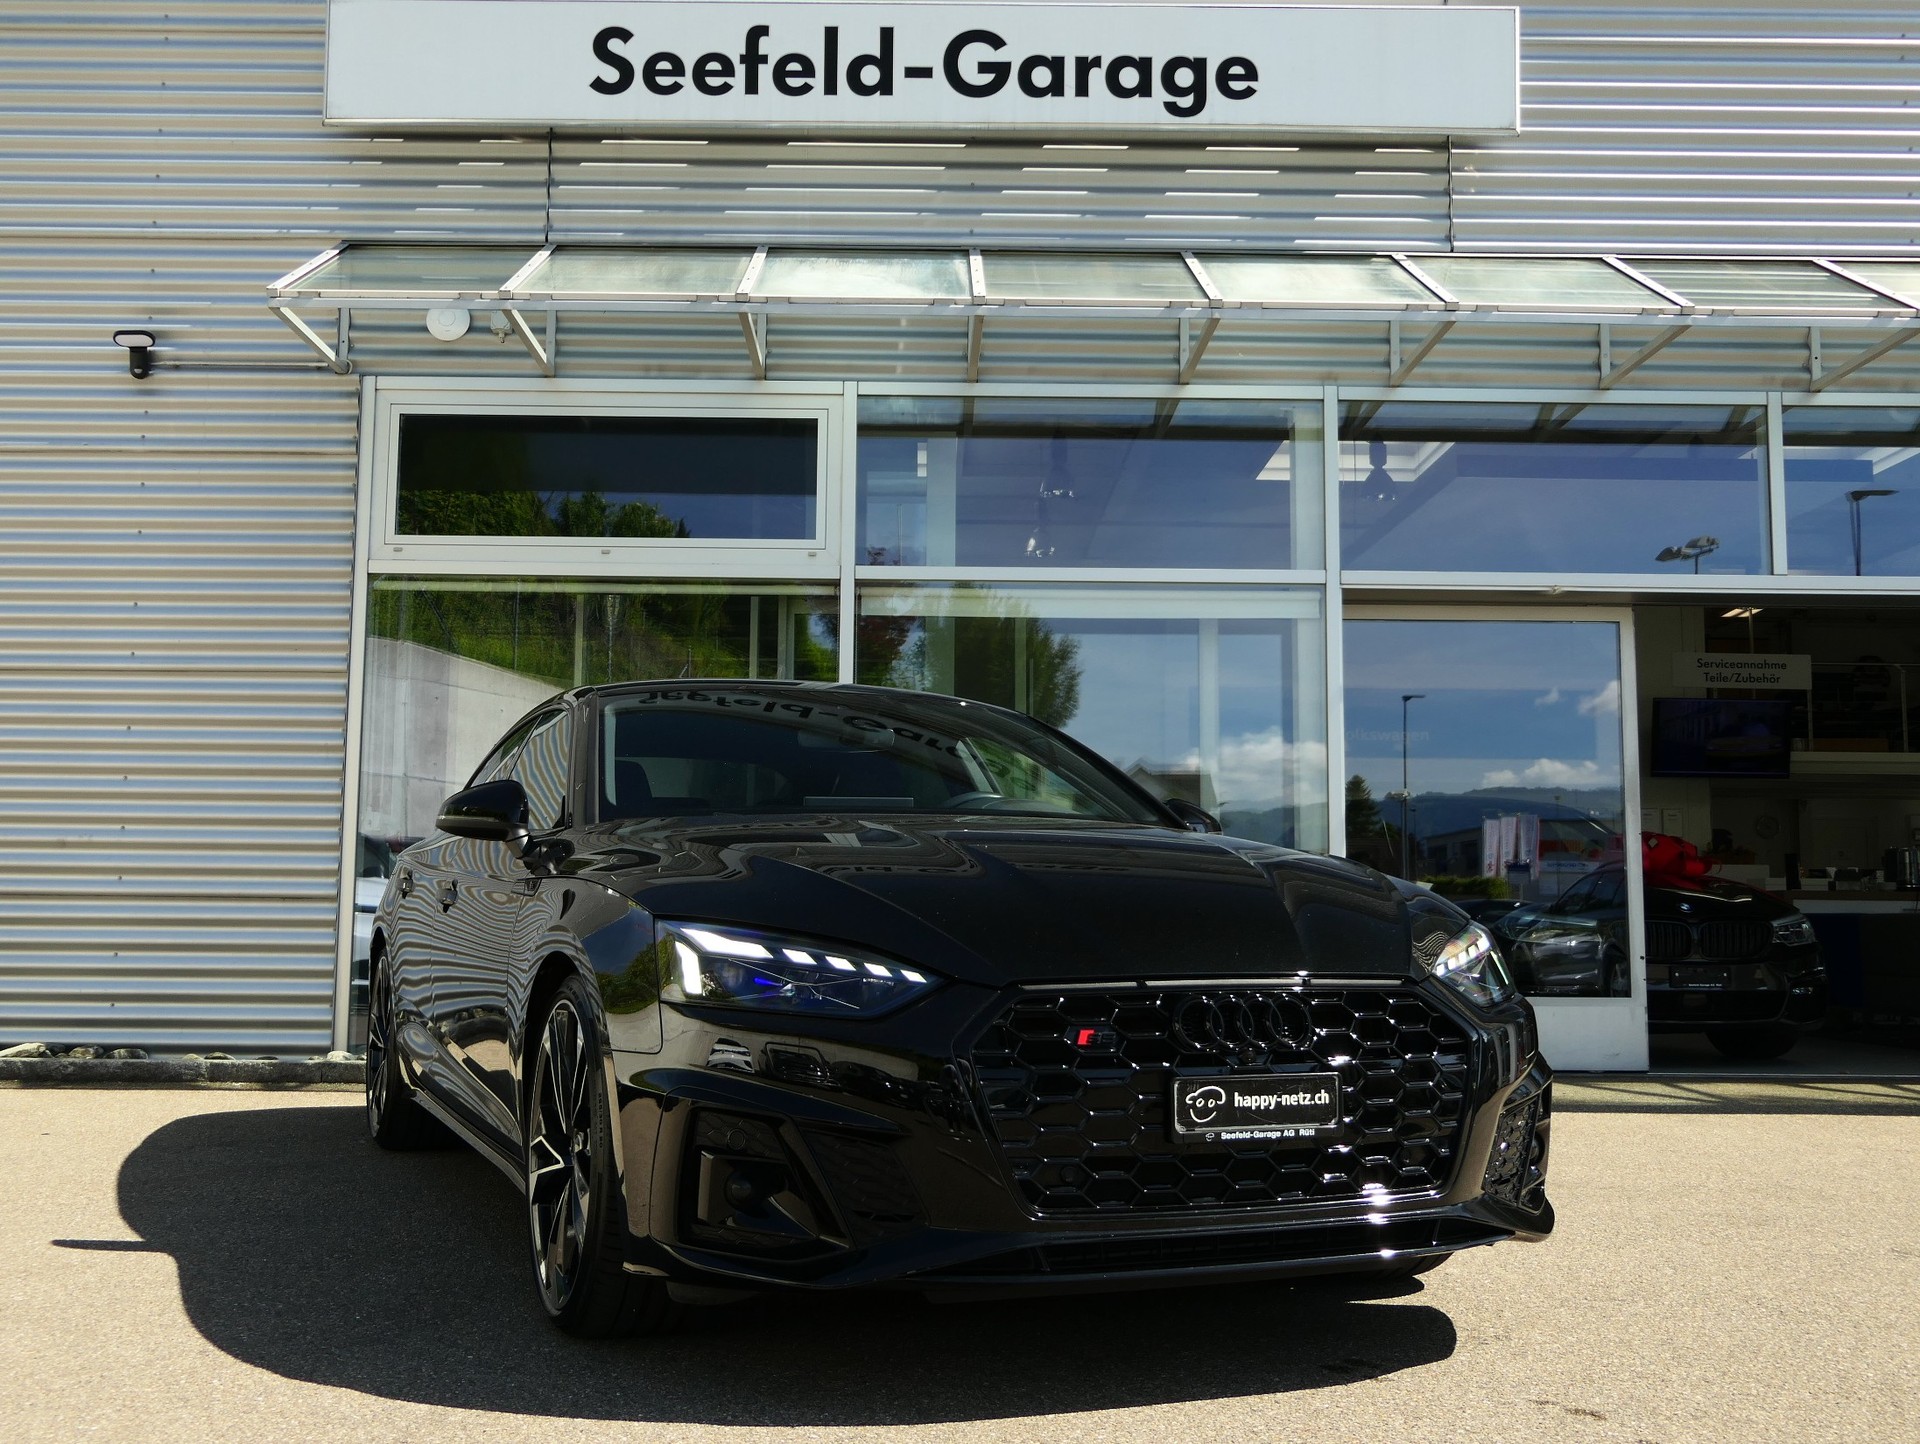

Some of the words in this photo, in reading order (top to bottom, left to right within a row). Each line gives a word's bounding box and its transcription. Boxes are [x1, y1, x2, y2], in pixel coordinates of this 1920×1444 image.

[588, 24, 1260, 118] Seefeld-Garage
[1696, 657, 1787, 670] Serviceannahme
[1703, 672, 1781, 683] Teile/Zubehör
[1233, 1089, 1330, 1110] happy-netz.ch
[1220, 1130, 1281, 1140] Seefeld-Garage
[1282, 1129, 1295, 1137] AG
[1299, 1128, 1315, 1136] Rüti
